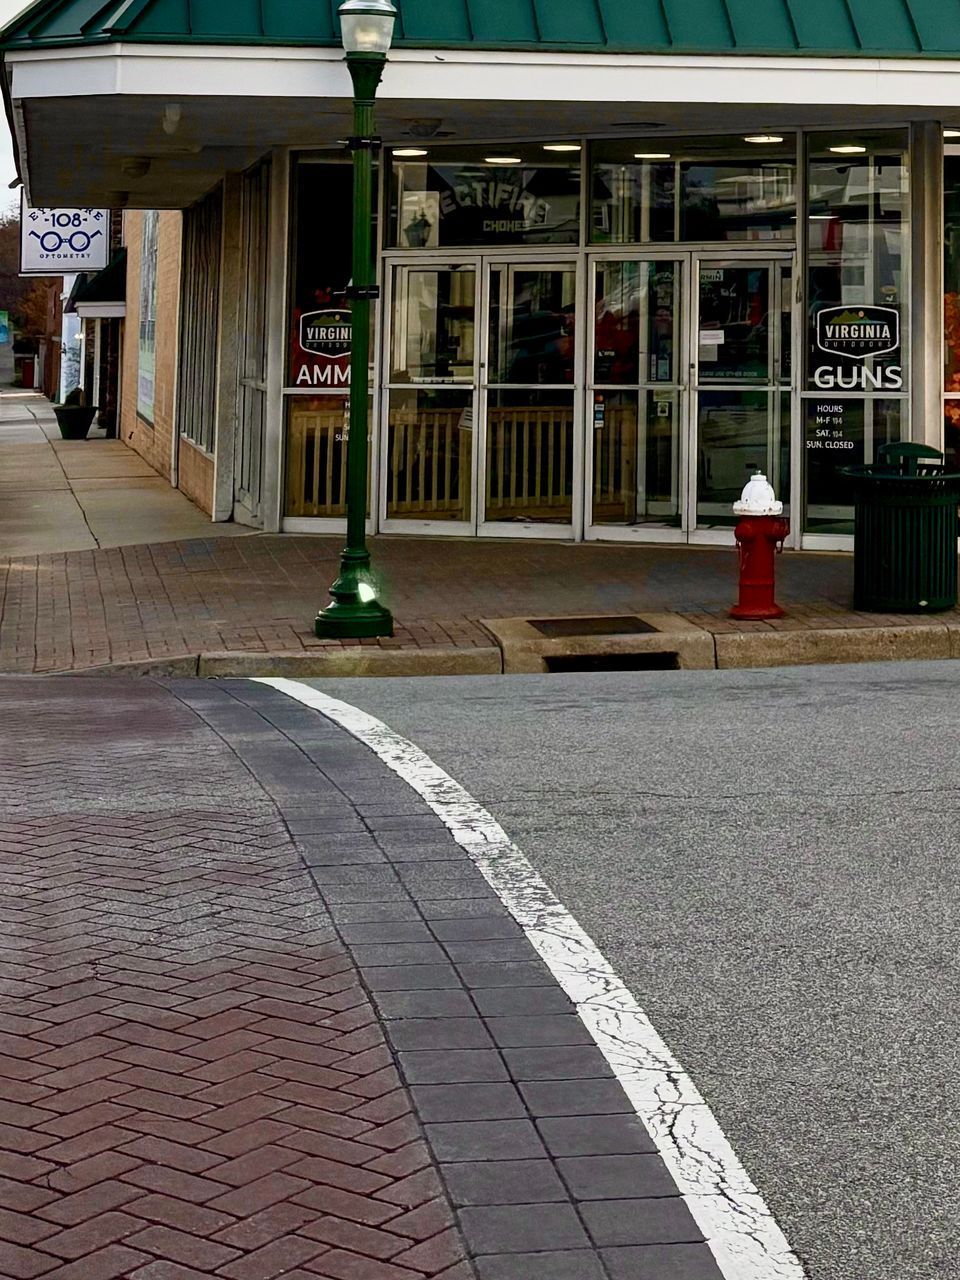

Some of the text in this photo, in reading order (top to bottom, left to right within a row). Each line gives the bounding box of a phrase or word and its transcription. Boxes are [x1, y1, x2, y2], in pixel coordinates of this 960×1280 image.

[306, 327, 353, 340] VIRGINI
[825, 324, 891, 339] VIRGINIA
[295, 364, 352, 385] AMM
[813, 365, 903, 389] GUNS
[816, 404, 844, 413] HOURS
[815, 416, 831, 424] M-F
[815, 429, 831, 437] SAT.
[806, 440, 854, 449] SUN. CLOSED
